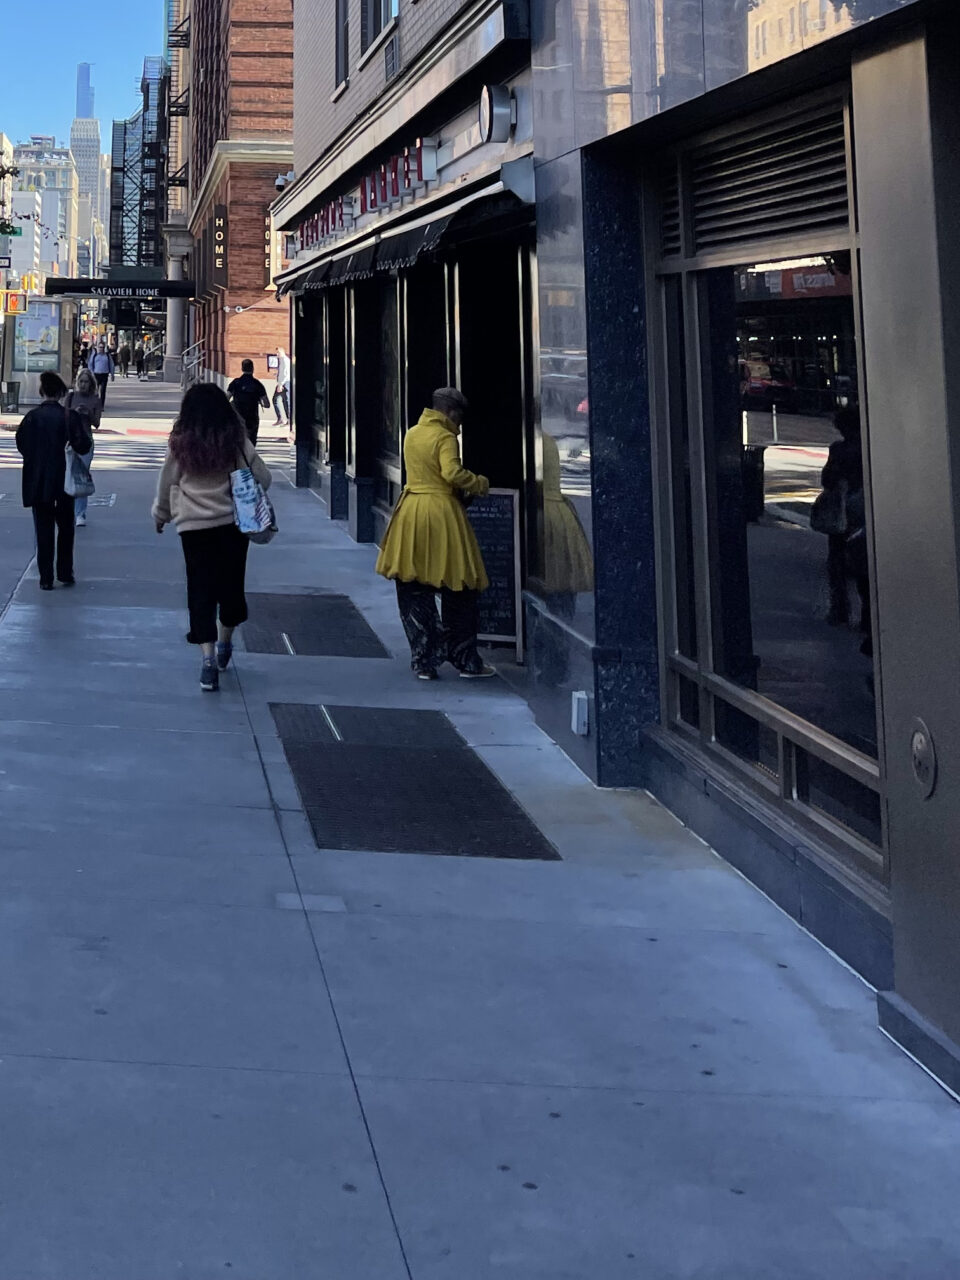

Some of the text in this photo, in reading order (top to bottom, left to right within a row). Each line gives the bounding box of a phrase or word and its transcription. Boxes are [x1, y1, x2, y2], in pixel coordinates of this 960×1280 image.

[215, 218, 224, 268] HOME
[91, 287, 159, 296] SAFAVIEH HOME
